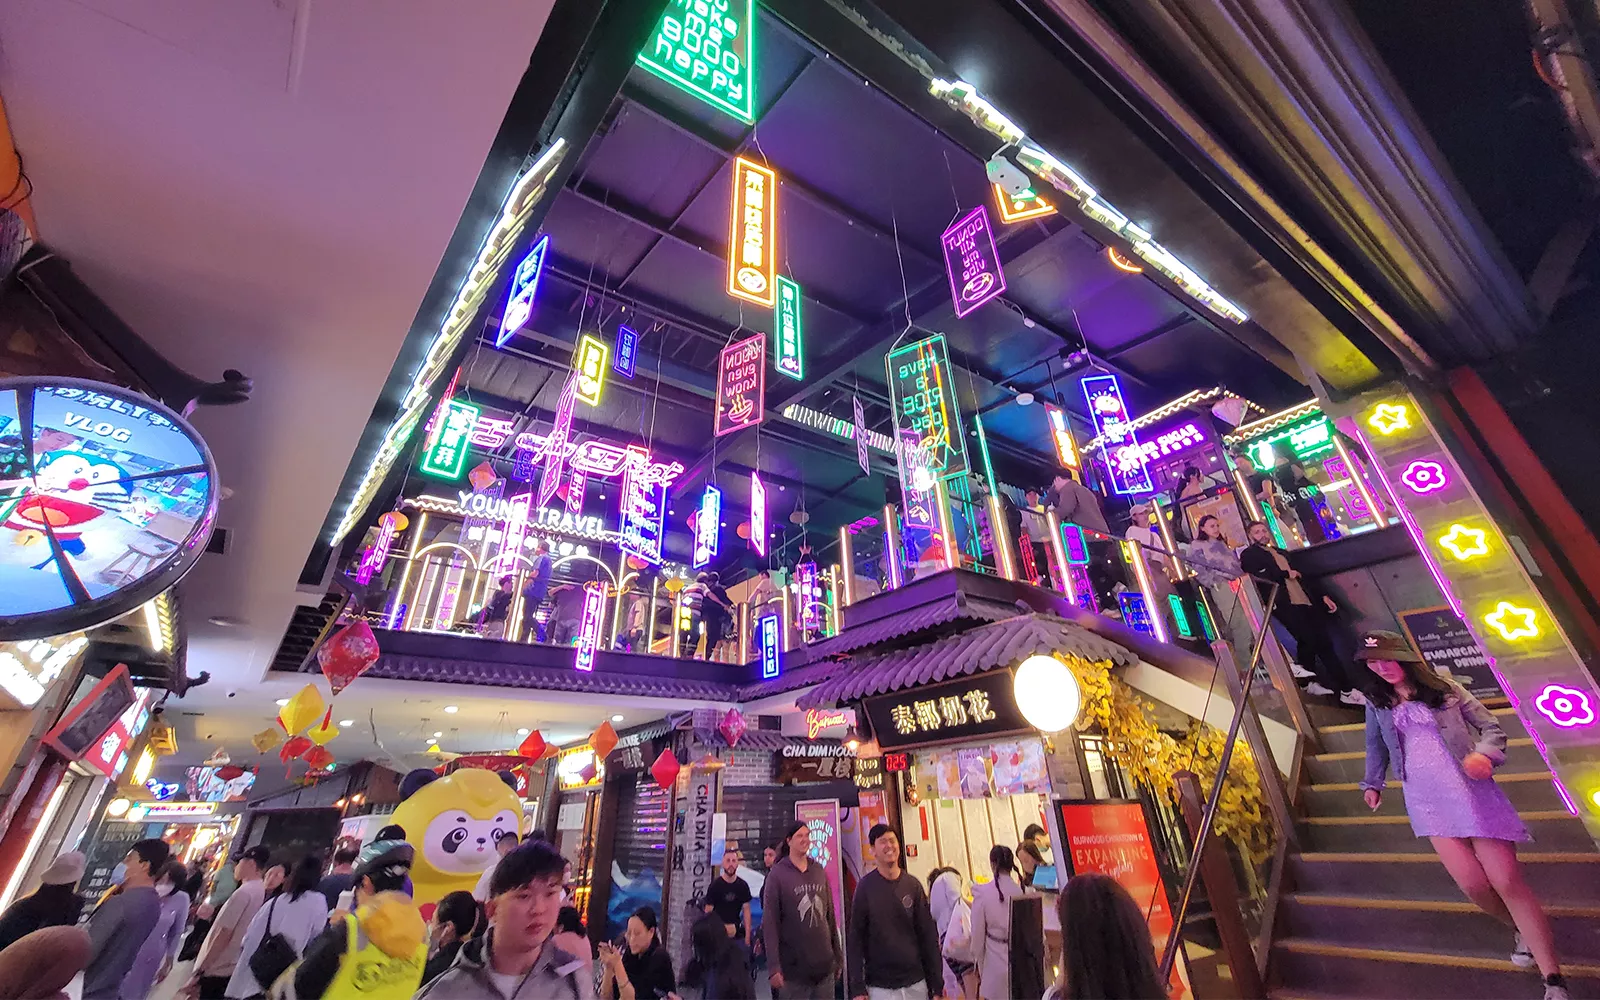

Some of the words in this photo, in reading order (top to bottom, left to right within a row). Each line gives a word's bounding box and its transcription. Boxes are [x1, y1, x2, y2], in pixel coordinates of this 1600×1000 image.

[684, 12, 723, 45] me
[655, 33, 743, 102] happy
[63, 411, 133, 444] VLOG
[783, 403, 856, 440] BURWOOD
[536, 504, 607, 536] TRAVEL
[782, 744, 806, 758] CHA
[807, 744, 828, 758] DIM
[696, 784, 709, 817] CHA
[1073, 835, 1105, 845] BURWOOD
[1076, 845, 1149, 866] EXPANDING
